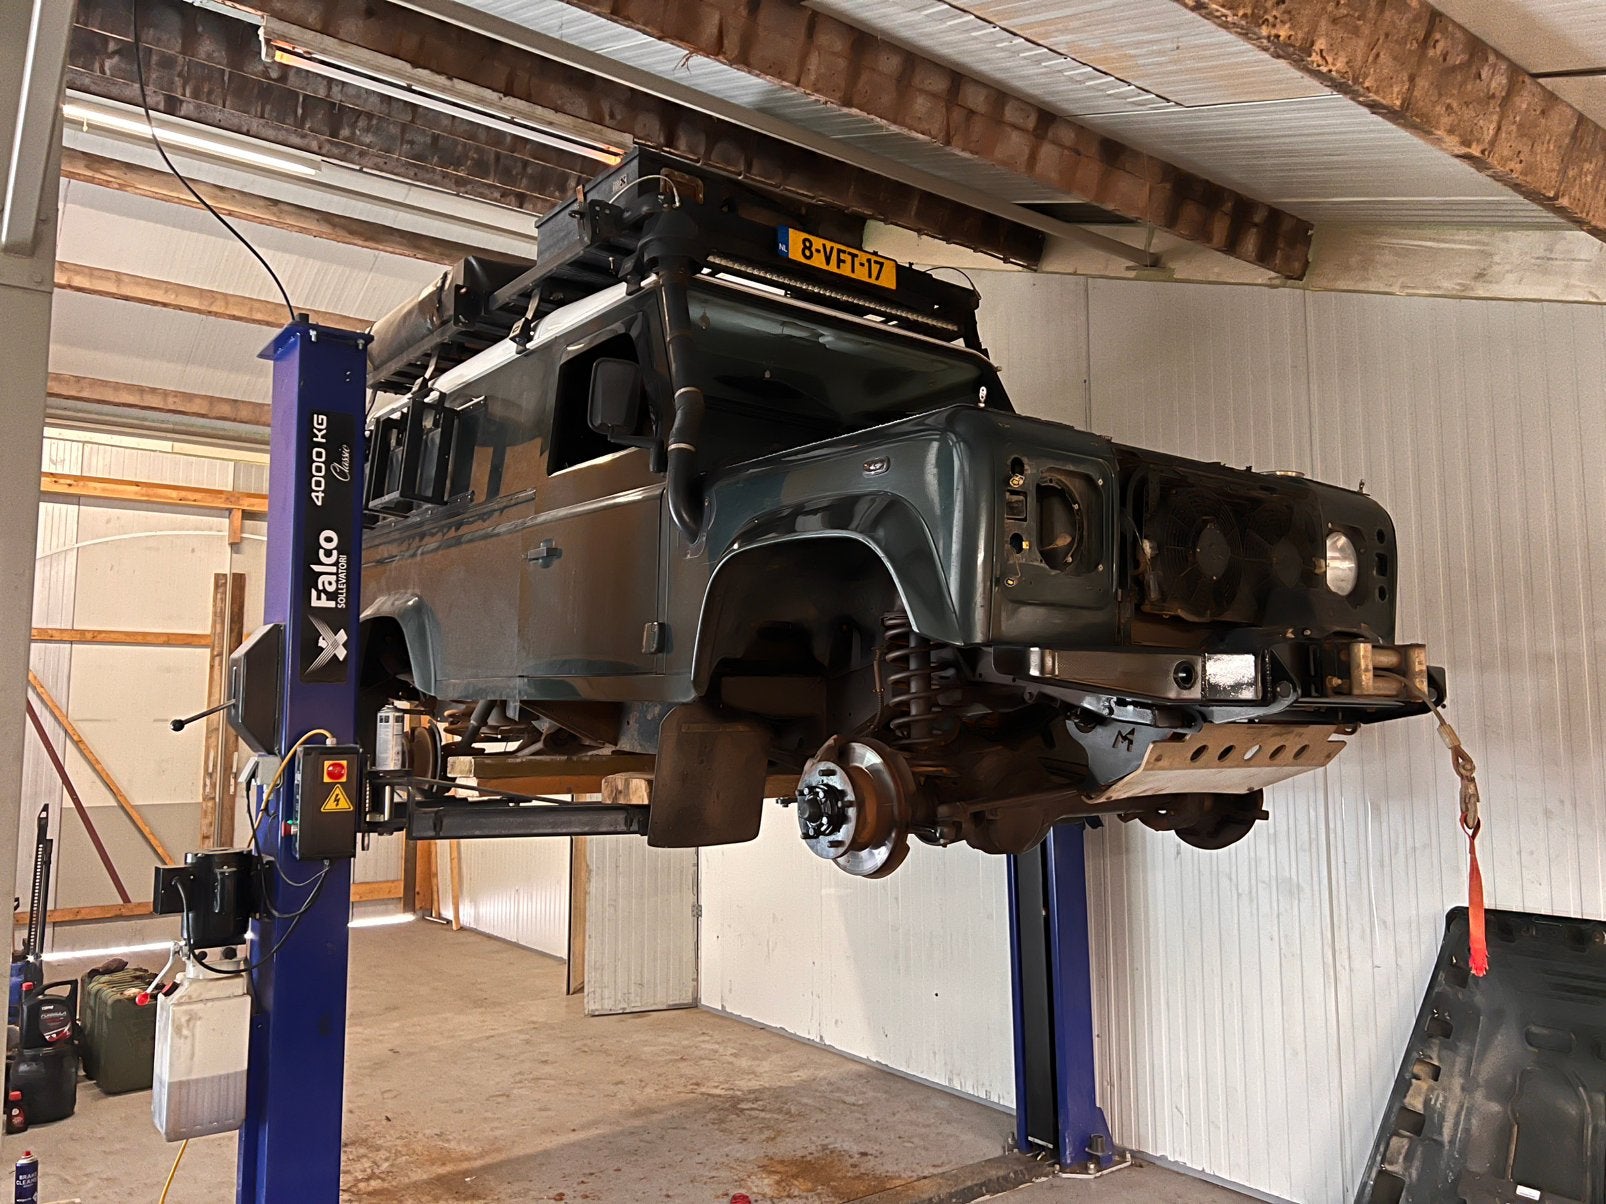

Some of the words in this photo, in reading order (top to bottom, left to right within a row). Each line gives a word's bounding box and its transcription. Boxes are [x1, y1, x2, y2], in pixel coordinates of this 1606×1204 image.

[778, 243, 788, 253] NL
[801, 237, 885, 281] 8-VFT-17
[312, 413, 327, 443] KG
[311, 447, 326, 507] 4000
[330, 444, 350, 481] Classic
[309, 529, 339, 608] Falco
[337, 554, 347, 609] SOLLEVATORI
